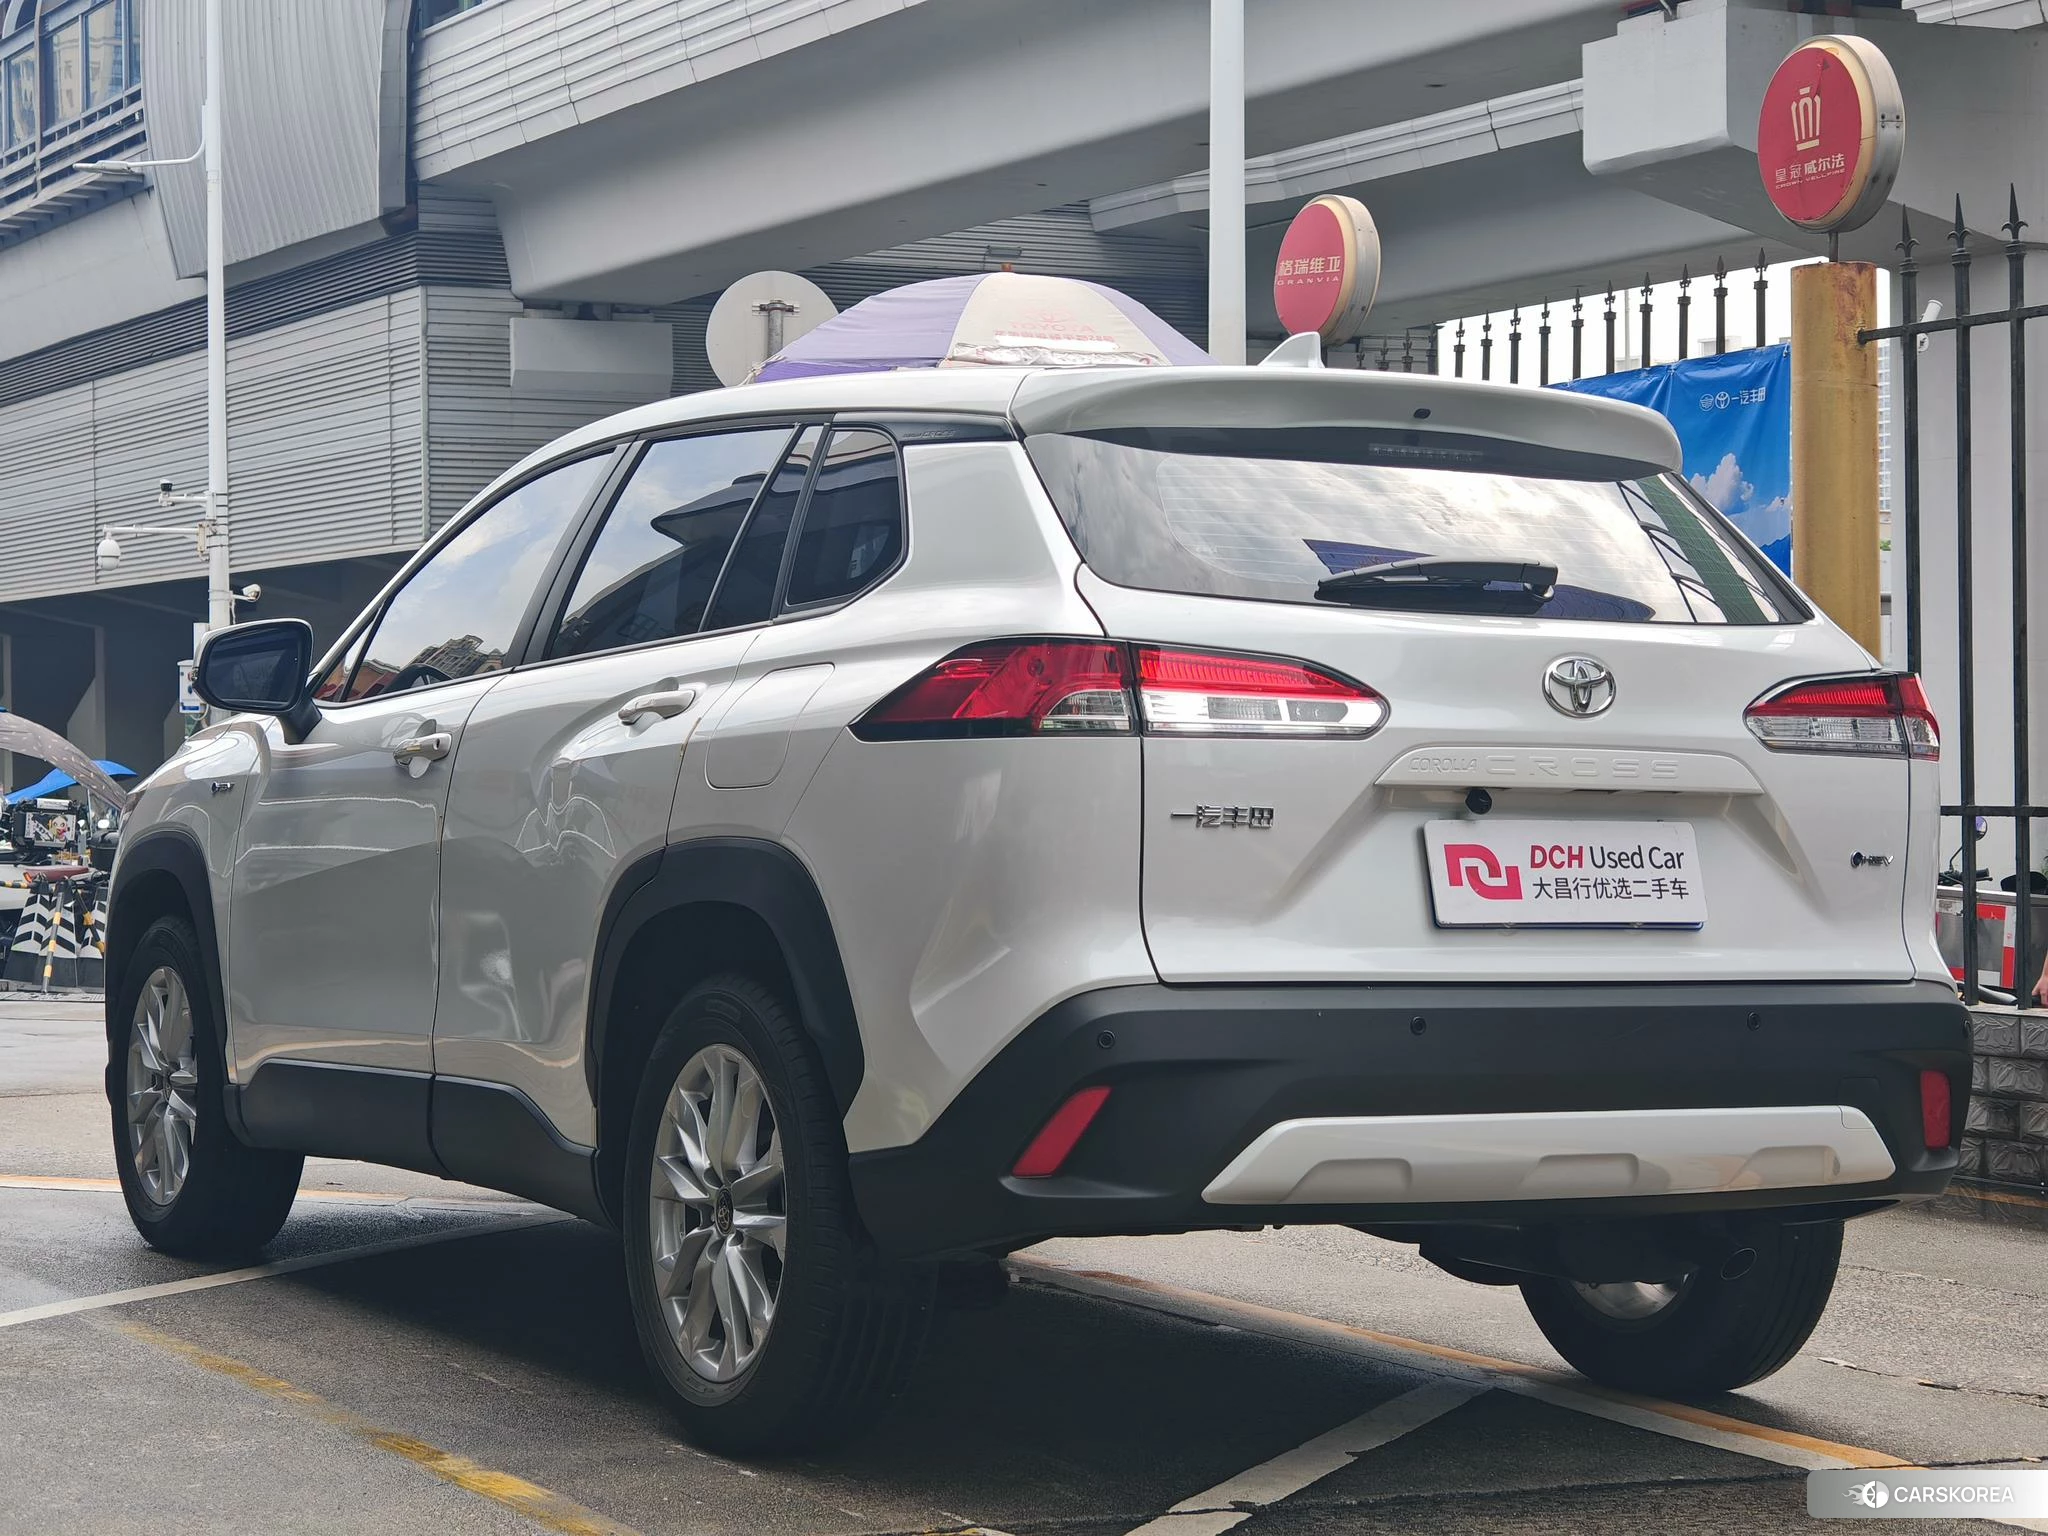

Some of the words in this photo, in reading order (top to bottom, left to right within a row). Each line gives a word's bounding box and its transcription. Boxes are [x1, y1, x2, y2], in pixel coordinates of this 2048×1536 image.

[1775, 153, 1845, 183] 皇冠威尔法
[1278, 255, 1341, 276] 格瑞维亚
[1277, 275, 1339, 286] GRANVIA
[1731, 386, 1766, 405] 一汽丰田
[1409, 757, 1478, 774] COROLLA
[1485, 755, 1680, 779] CROSS
[1170, 804, 1275, 828] 一汽丰田
[1530, 845, 1584, 869] DCH
[1589, 845, 1643, 869] Used
[1648, 846, 1685, 869] Car
[1532, 877, 1689, 900] 大昌行优选二手车
